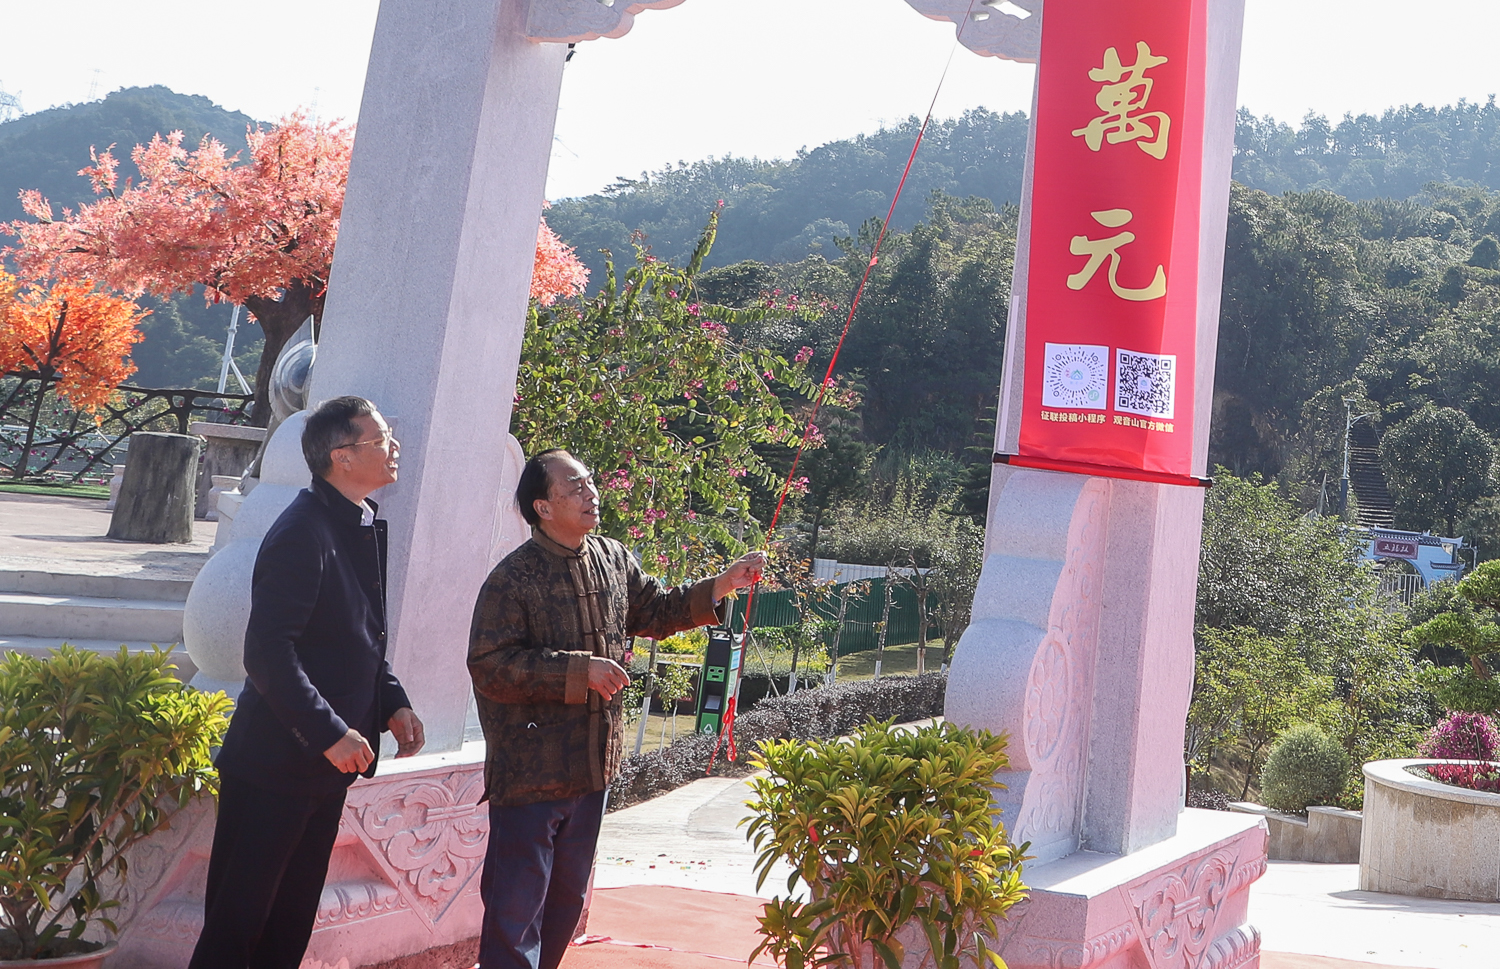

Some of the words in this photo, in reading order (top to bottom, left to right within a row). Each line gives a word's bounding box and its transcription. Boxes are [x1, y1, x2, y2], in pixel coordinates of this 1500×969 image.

[1041, 411, 1106, 424] 征联投稿小程序
[1112, 415, 1175, 433] 观音山官方微信
